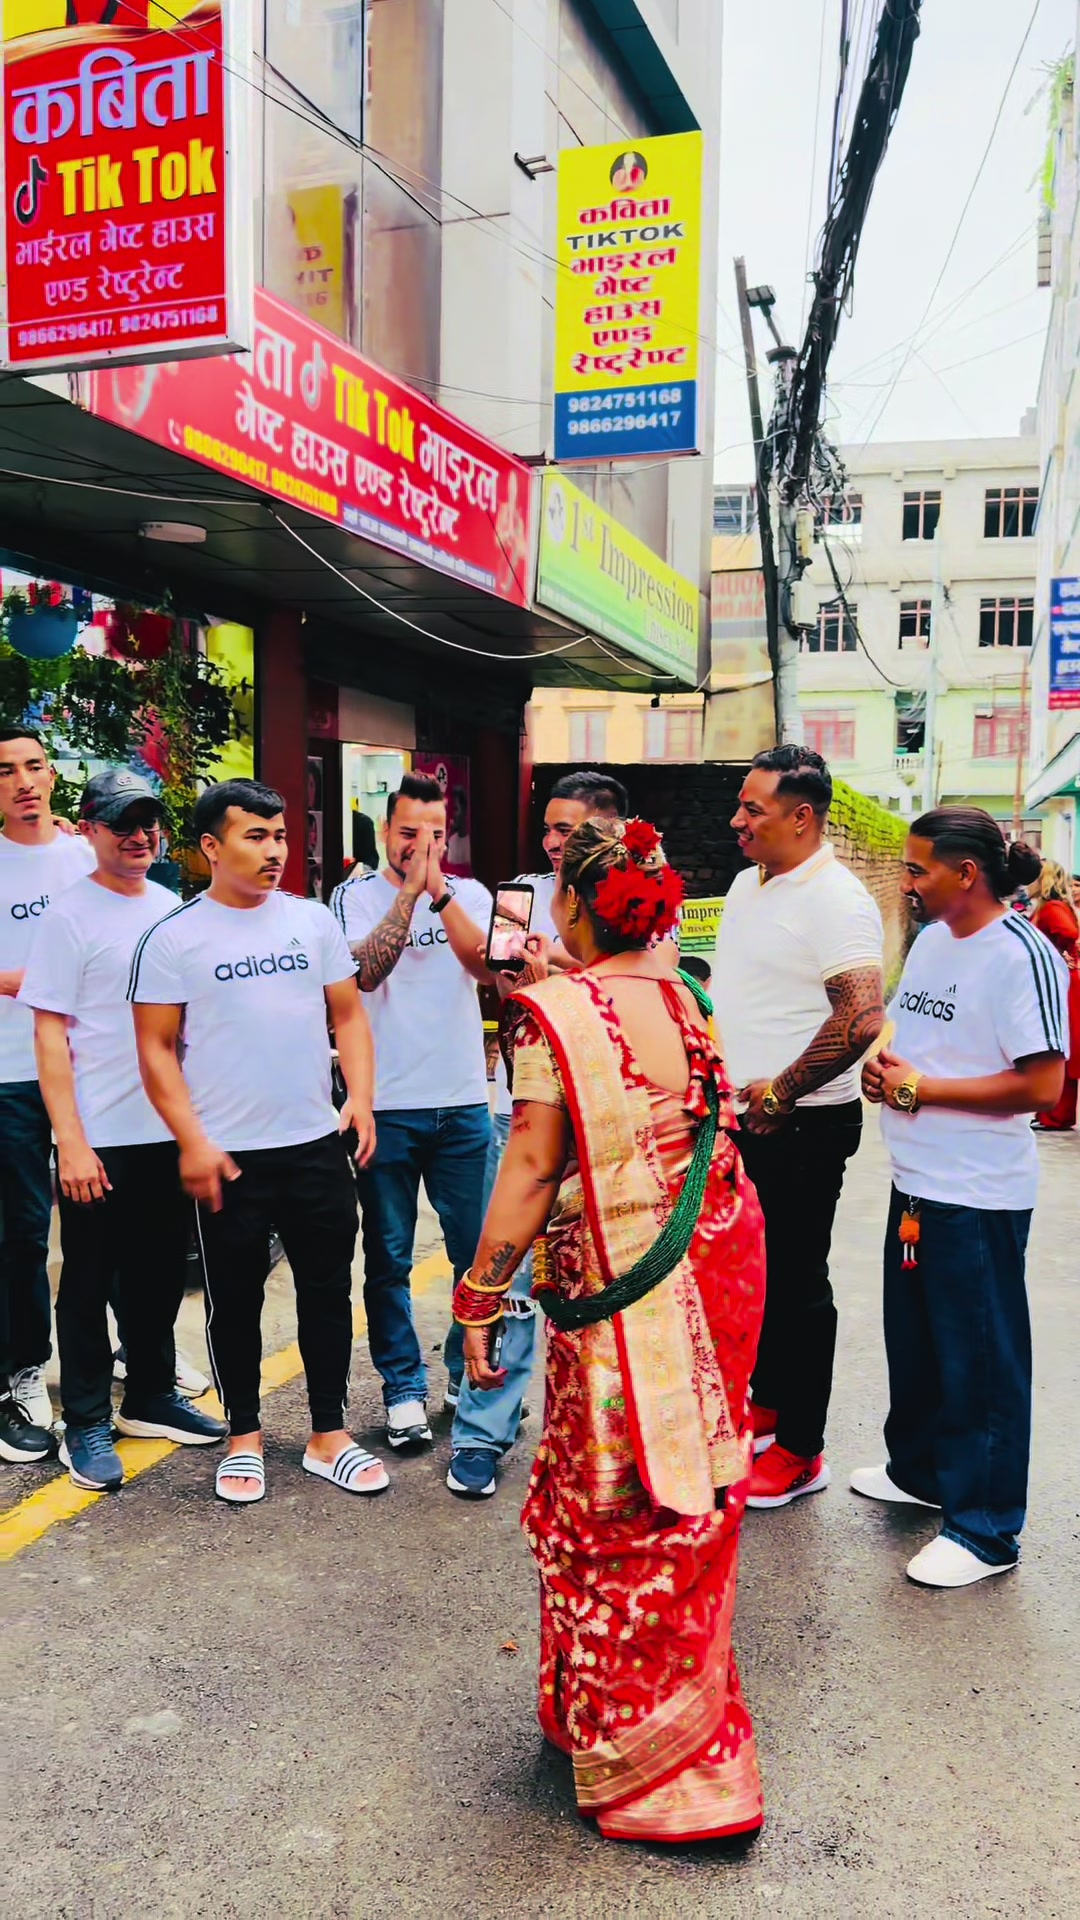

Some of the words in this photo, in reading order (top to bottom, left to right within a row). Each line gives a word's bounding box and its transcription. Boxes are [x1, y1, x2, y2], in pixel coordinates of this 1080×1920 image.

[12, 48, 215, 144] कबिता
[57, 154, 124, 217] Tik
[133, 139, 217, 204] Tok
[152, 213, 216, 248] हाउस
[566, 223, 684, 250] TIKTOK
[44, 277, 90, 306] एण्ड
[584, 300, 661, 325] हाउस
[592, 326, 652, 348] एण्ड
[332, 363, 370, 437] Tik
[373, 388, 415, 463] Tok
[568, 387, 681, 413] 9824751168
[567, 410, 681, 435] 9866296417
[291, 421, 349, 487] हाउस
[600, 523, 694, 634] Impression
[681, 905, 724, 922] Impre
[214, 952, 309, 982] adidas
